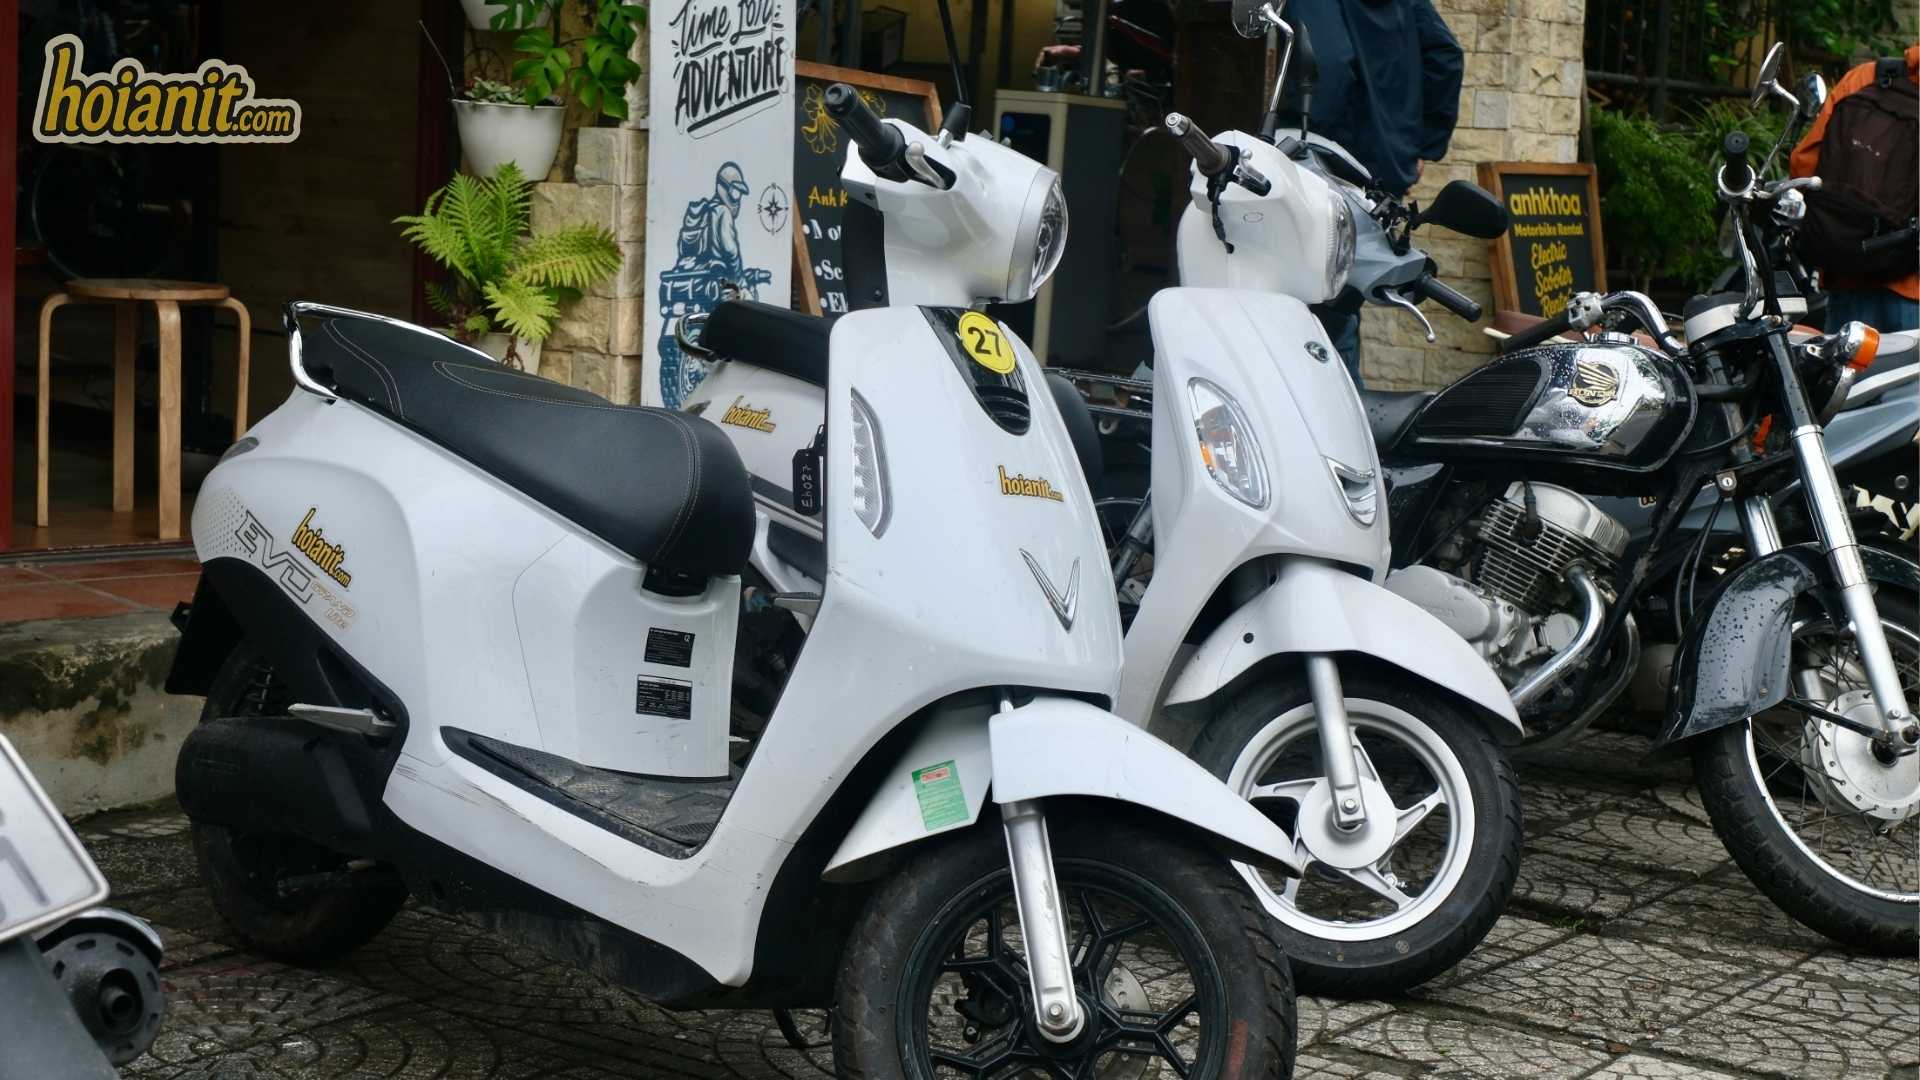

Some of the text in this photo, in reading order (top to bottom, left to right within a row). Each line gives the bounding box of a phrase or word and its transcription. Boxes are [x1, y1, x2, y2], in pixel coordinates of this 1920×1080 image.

[669, 0, 731, 56] Time
[674, 36, 785, 126] ADVENTURE
[808, 185, 837, 208] Anh
[1510, 187, 1581, 216] anhkhoa
[1514, 222, 1556, 237] Motorbike
[821, 259, 843, 280] Sc
[1531, 241, 1567, 269] Electric
[827, 291, 848, 313] El
[1541, 288, 1572, 319] Renta
[967, 326, 1003, 358] 27
[721, 395, 776, 433] hoianit
[998, 464, 1064, 502] hoianit
[235, 509, 317, 604] EVO
[291, 507, 352, 588] hoianit.com
